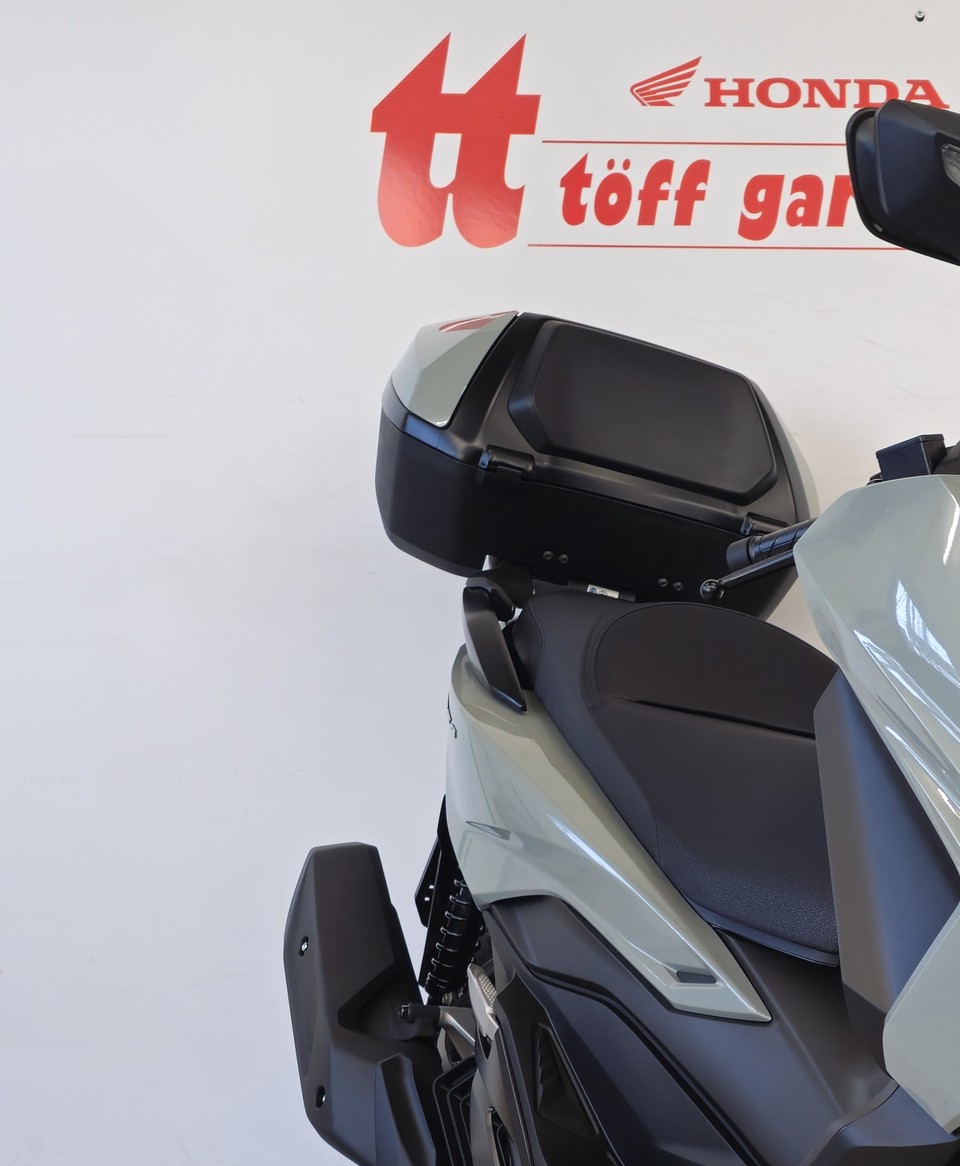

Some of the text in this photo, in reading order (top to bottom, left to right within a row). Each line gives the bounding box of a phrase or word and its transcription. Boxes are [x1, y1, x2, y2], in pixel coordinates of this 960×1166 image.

[703, 77, 950, 109] HONDA
[559, 152, 711, 227] töff
[737, 173, 856, 241] gar
